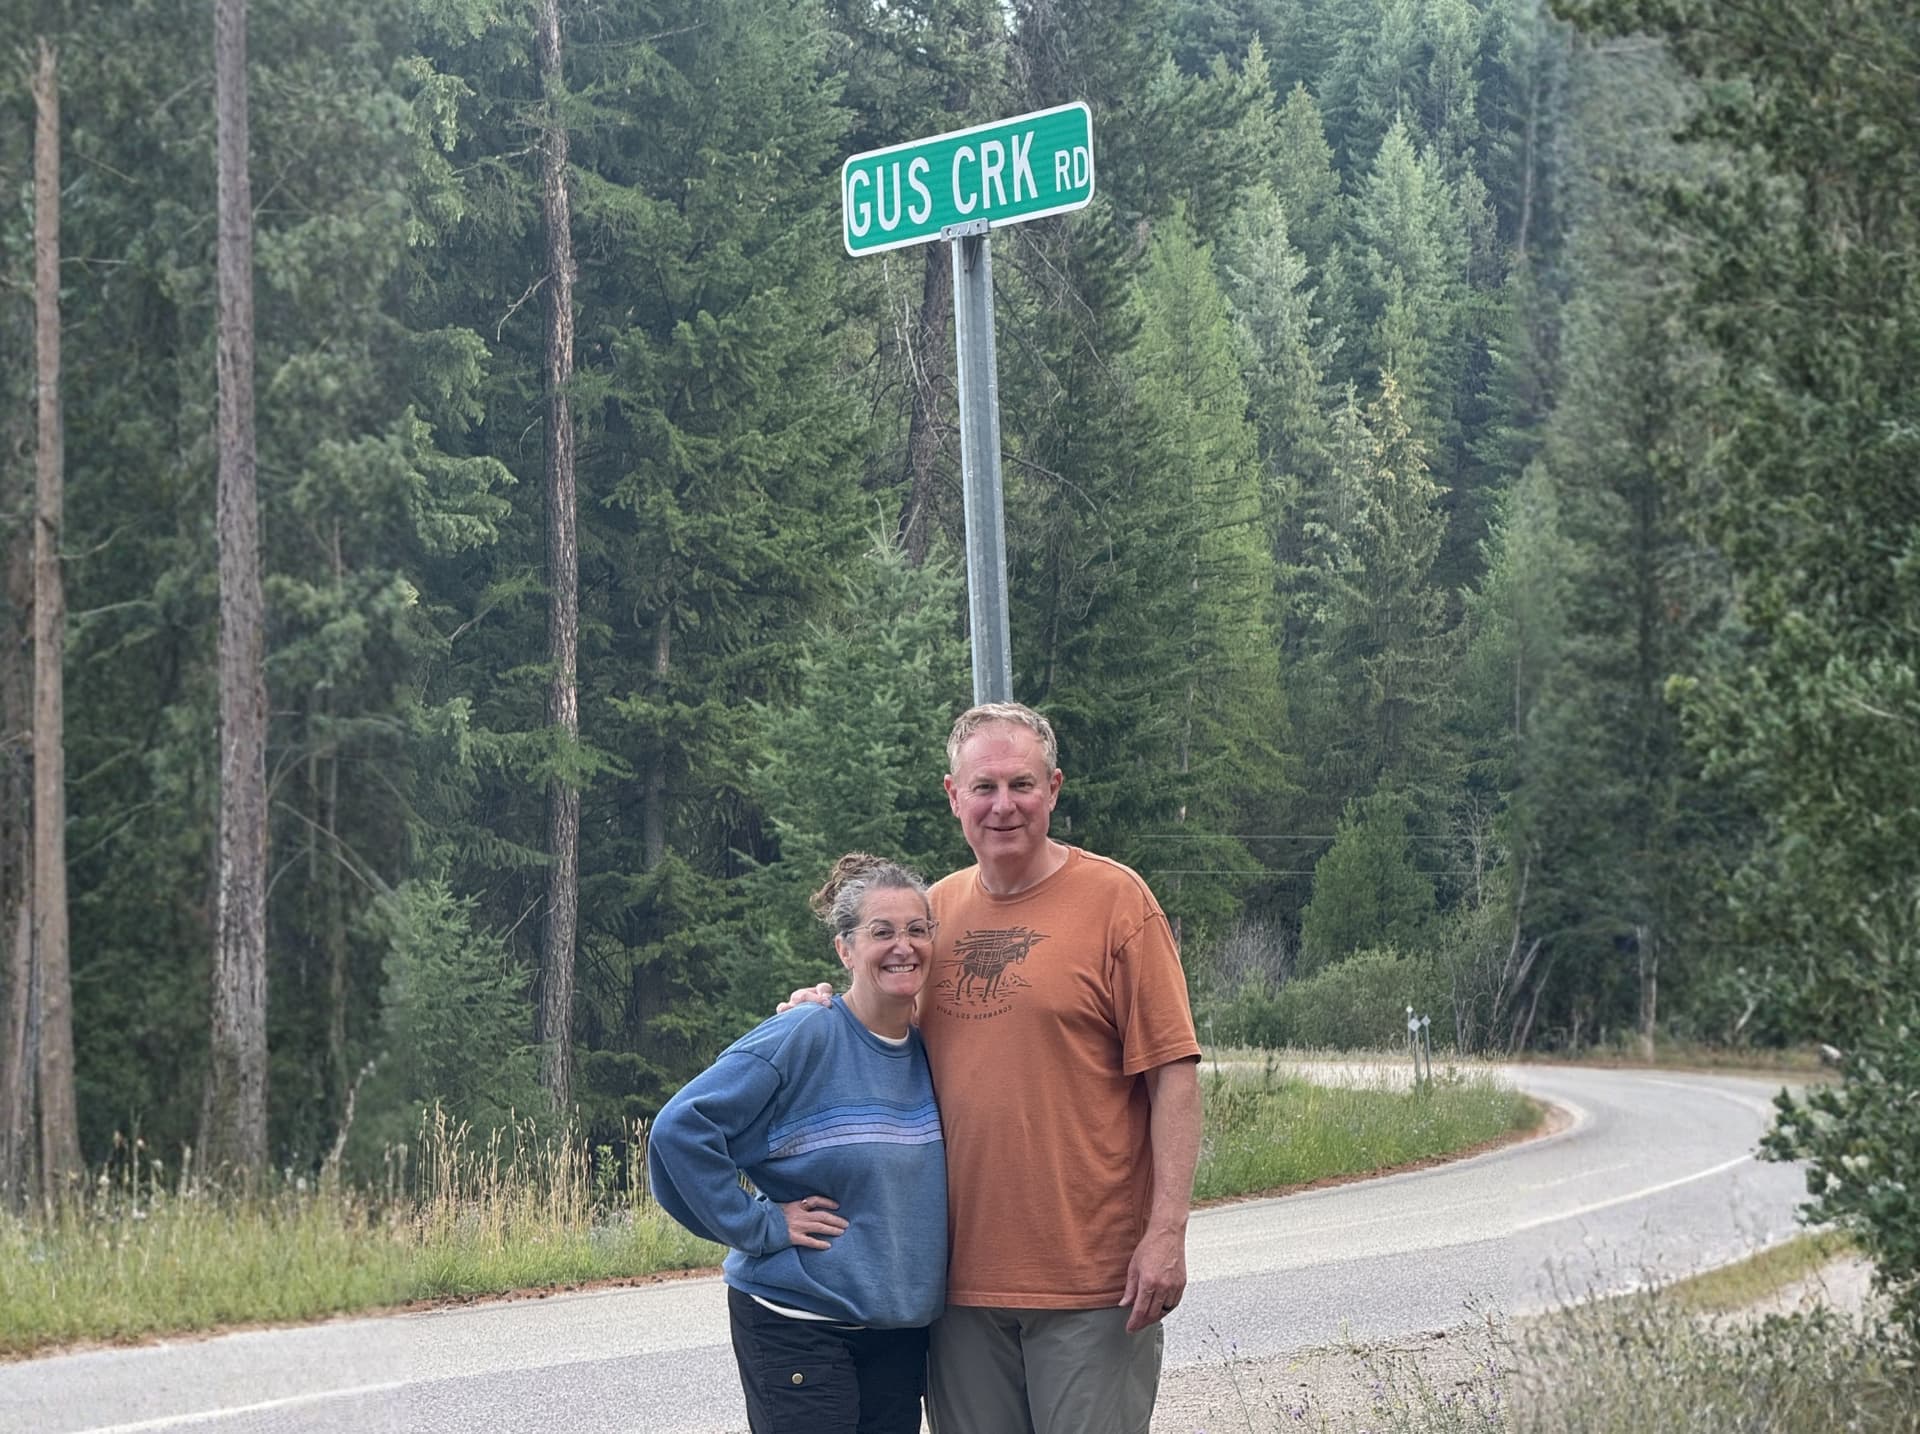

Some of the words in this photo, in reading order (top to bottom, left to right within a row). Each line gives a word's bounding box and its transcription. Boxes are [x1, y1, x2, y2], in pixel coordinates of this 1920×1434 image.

[848, 156, 933, 238] GUS
[952, 130, 1039, 215] CRK
[1054, 145, 1089, 193] RD
